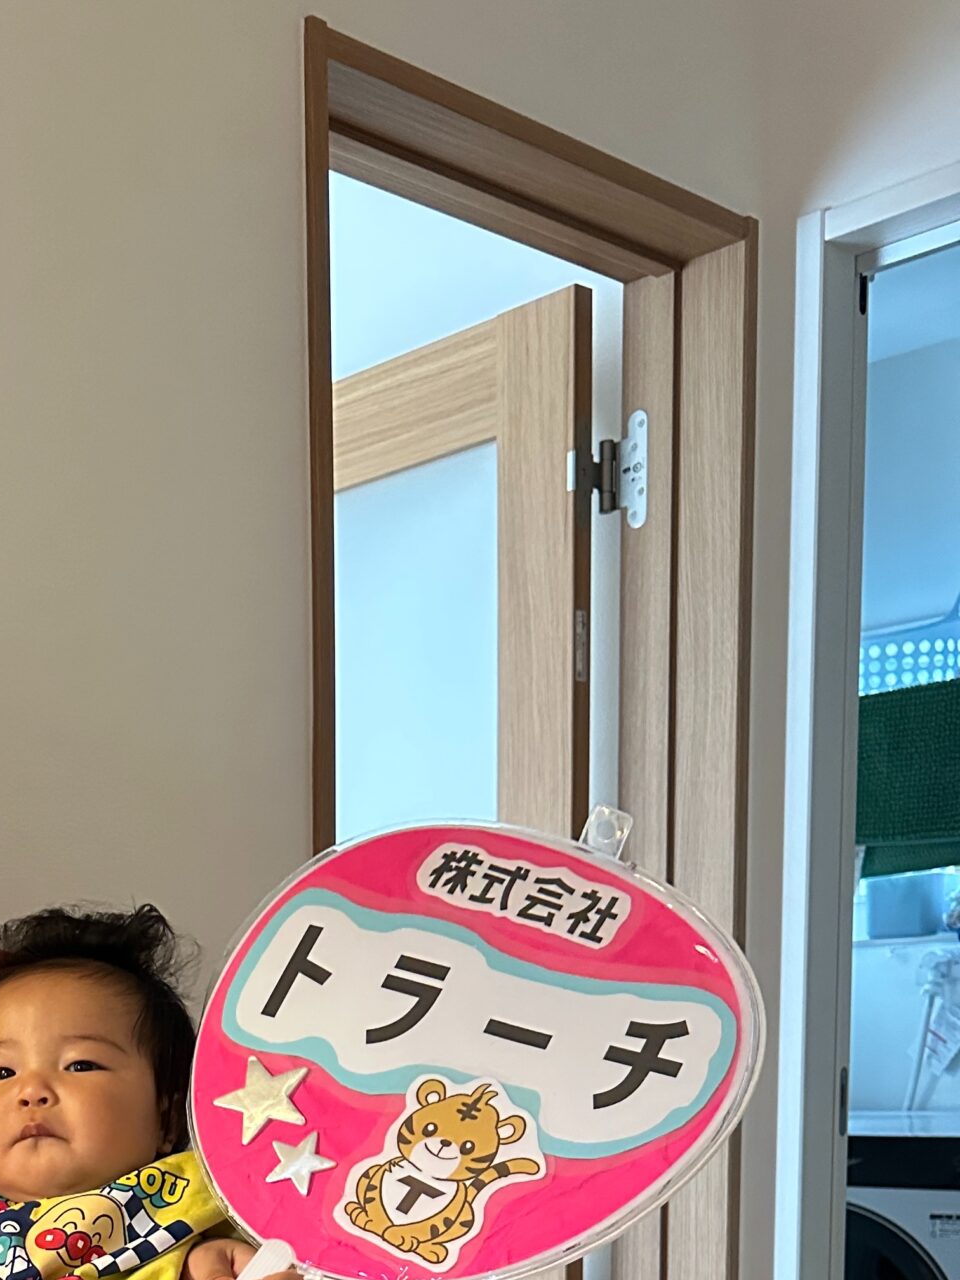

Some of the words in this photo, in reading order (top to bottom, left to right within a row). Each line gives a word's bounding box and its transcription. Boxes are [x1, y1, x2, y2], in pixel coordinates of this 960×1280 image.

[429, 850, 620, 944] 株式会社
[261, 924, 690, 1110] トラーチ
[396, 1175, 446, 1215] T
